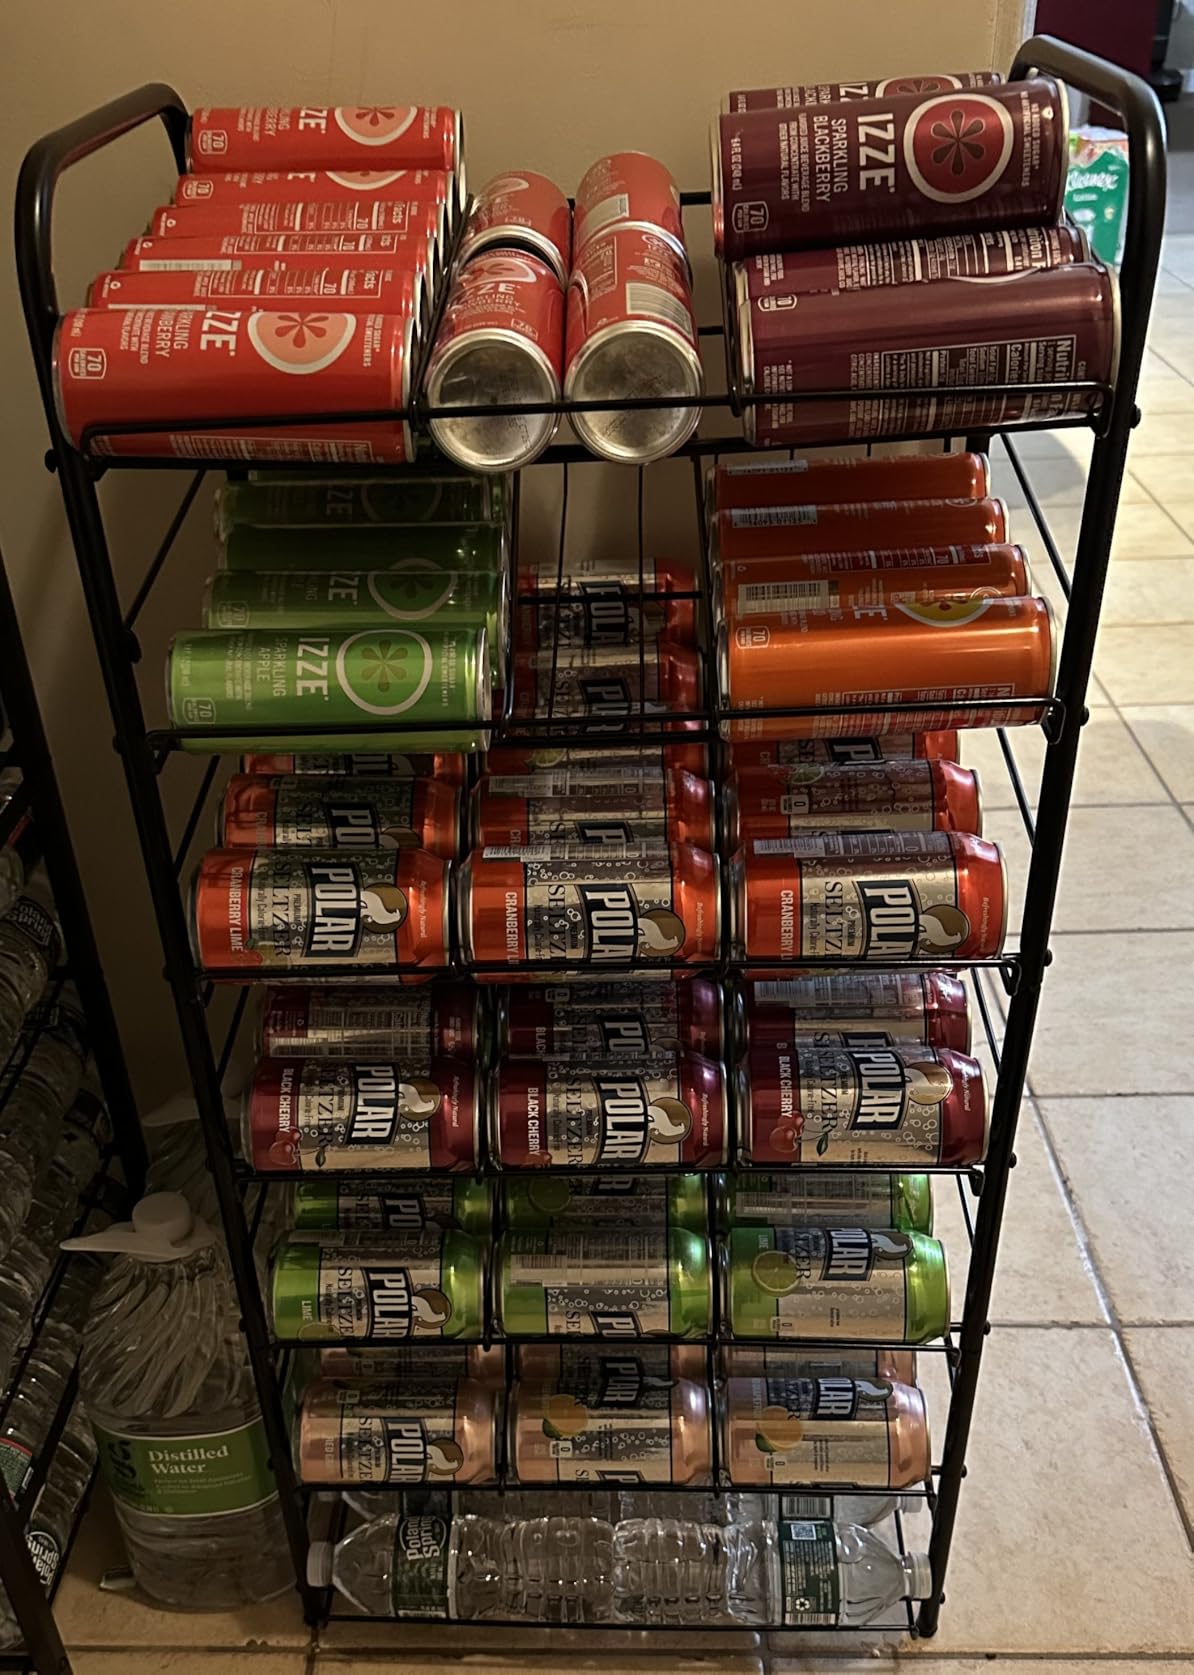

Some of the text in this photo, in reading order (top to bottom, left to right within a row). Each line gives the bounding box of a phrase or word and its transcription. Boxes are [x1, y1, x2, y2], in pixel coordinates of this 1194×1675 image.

[839, 81, 869, 103] IZ
[211, 134, 226, 149] 70
[298, 107, 327, 131] ZE
[789, 136, 799, 183] CONCENTRATE
[800, 153, 811, 190] BEVERAGE
[812, 115, 831, 203] BLACKBERRY
[831, 118, 849, 193] SPARKLING
[857, 112, 896, 192] IZZE
[1019, 136, 1031, 188] SWEETENERS
[356, 217, 369, 230] 70
[749, 207, 765, 225] 70
[323, 282, 337, 295] 70
[155, 310, 176, 359] ANBERRY
[173, 310, 193, 351] ARKLING
[200, 310, 240, 353] ZZE
[1035, 341, 1047, 368] Serving
[87, 354, 102, 372] 70
[328, 576, 360, 601] ZE
[752, 629, 766, 642] 70
[256, 647, 271, 682] APPLE
[272, 637, 289, 698] SPARKLING
[296, 637, 330, 697] IZZE
[198, 703, 213, 719] 70
[229, 866, 244, 953] CRANBERRY LIME
[272, 862, 292, 957] SELTZER
[310, 867, 358, 951] POLAR
[504, 891, 519, 954] CRANBERRY
[548, 884, 567, 958] SELTZ
[585, 891, 635, 963] POLA
[780, 889, 794, 951] CRANBERRY
[825, 881, 844, 957] SELTZ
[864, 885, 916, 961] POLA
[278, 1067, 295, 1134] BLACK CHERRY
[351, 1065, 395, 1139] POLAR
[778, 1055, 793, 1119] BLACK CHERRY
[818, 1051, 838, 1131] SELTZER
[852, 1052, 901, 1124] POLAR
[527, 1087, 541, 1156] BLACK CHERRY
[566, 1078, 584, 1166] SELTZER
[600, 1082, 645, 1160] POLAR
[758, 1234, 769, 1249] LIME
[795, 1231, 812, 1280] LTZER
[827, 1228, 869, 1276] OLAR
[301, 1300, 313, 1321] LIME
[337, 1266, 353, 1335] SELTZE
[817, 1378, 852, 1415] OLAR
[148, 1445, 229, 1462] Distilled
[150, 1463, 207, 1475] Water
[358, 1416, 373, 1480] SELTZE
[405, 1516, 424, 1561] Poland
[420, 1515, 441, 1559] Spring
